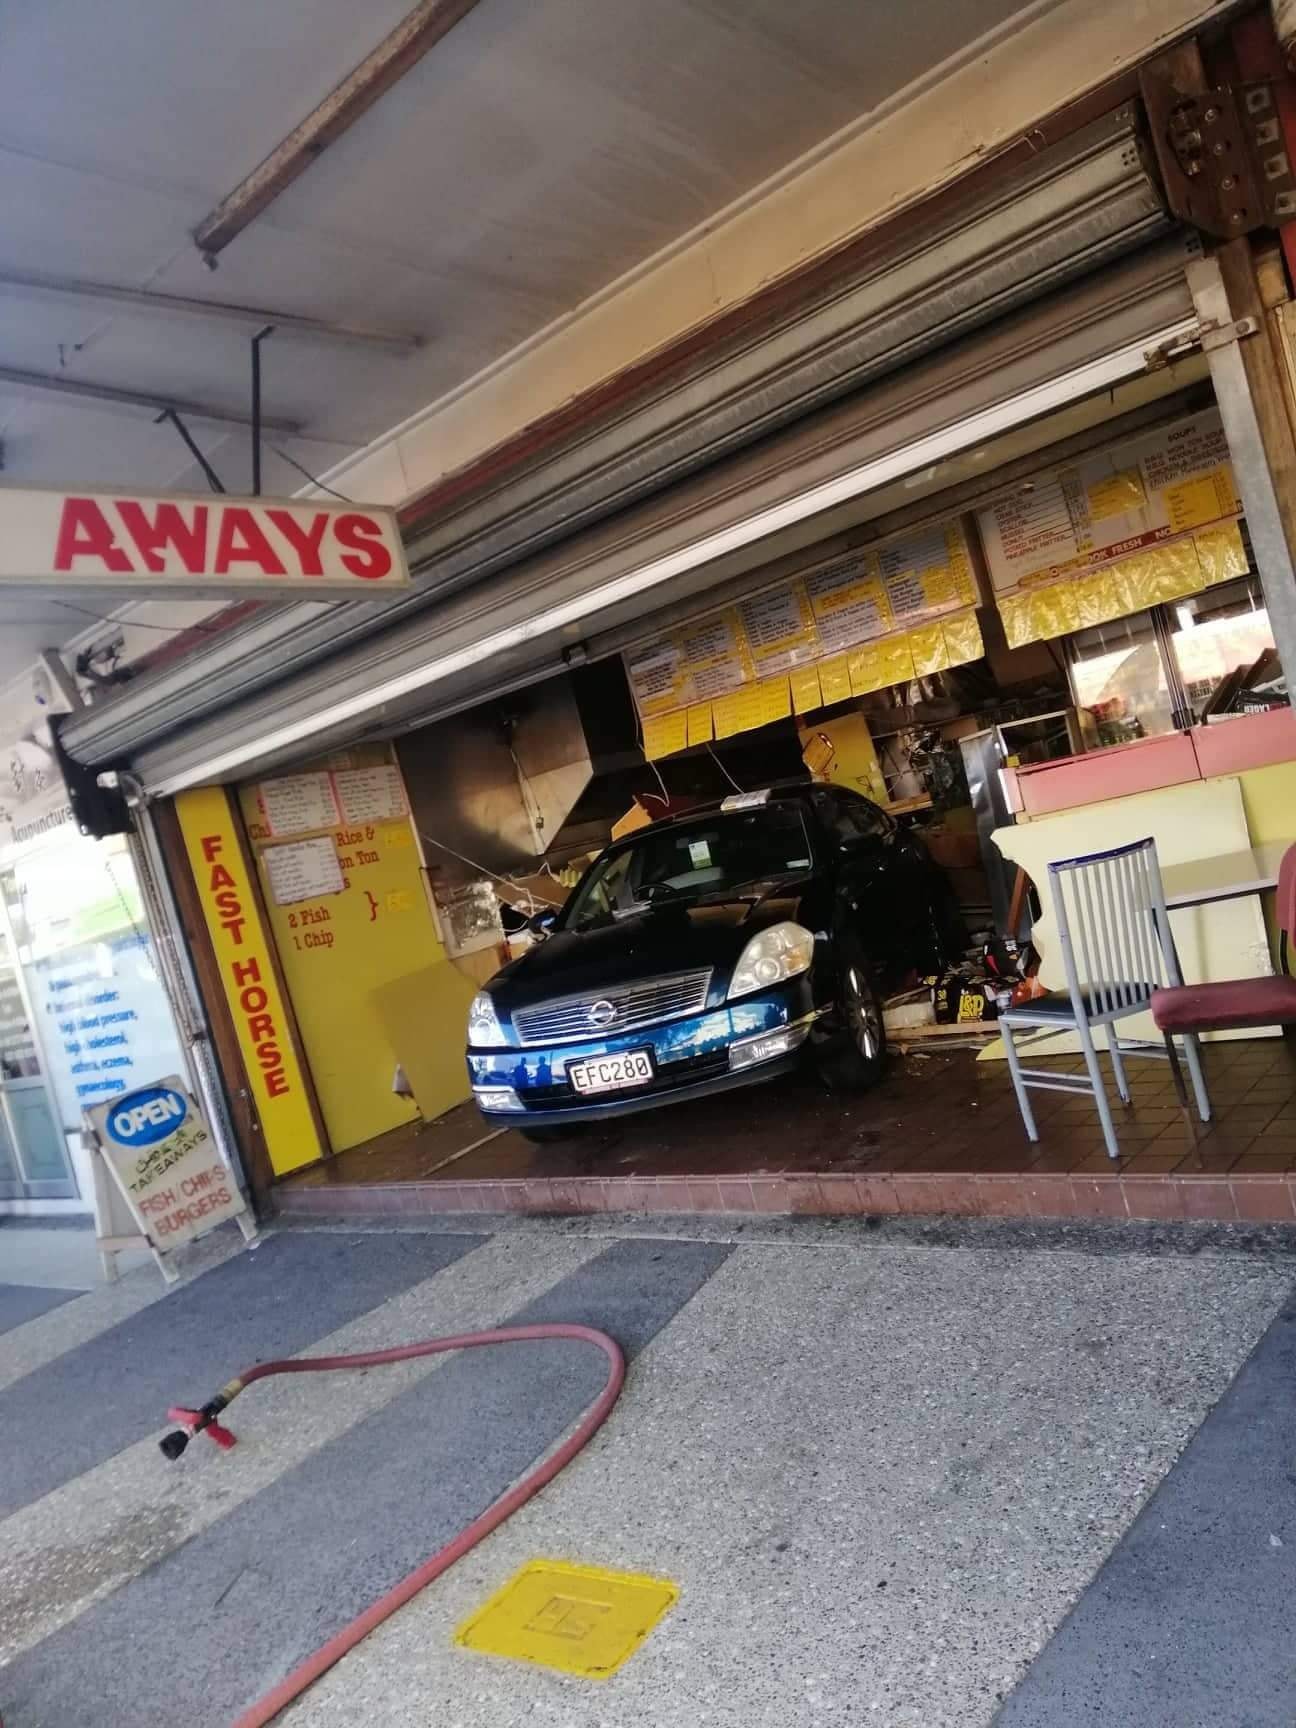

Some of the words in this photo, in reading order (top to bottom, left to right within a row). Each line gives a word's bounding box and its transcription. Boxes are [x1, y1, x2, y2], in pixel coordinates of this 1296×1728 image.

[53, 497, 393, 579] AWAYS
[1111, 537, 1143, 555] FRESH
[335, 828, 364, 848] Rice
[288, 912, 298, 929] 2
[300, 906, 332, 927] Fish
[293, 935, 302, 951] 1
[304, 929, 335, 949] Chip
[201, 835, 246, 945] FAST
[231, 957, 290, 1099] HORSE
[573, 1057, 649, 1088] EFC280
[114, 1093, 182, 1137] OPEN
[153, 1187, 232, 1236] BURGERS
